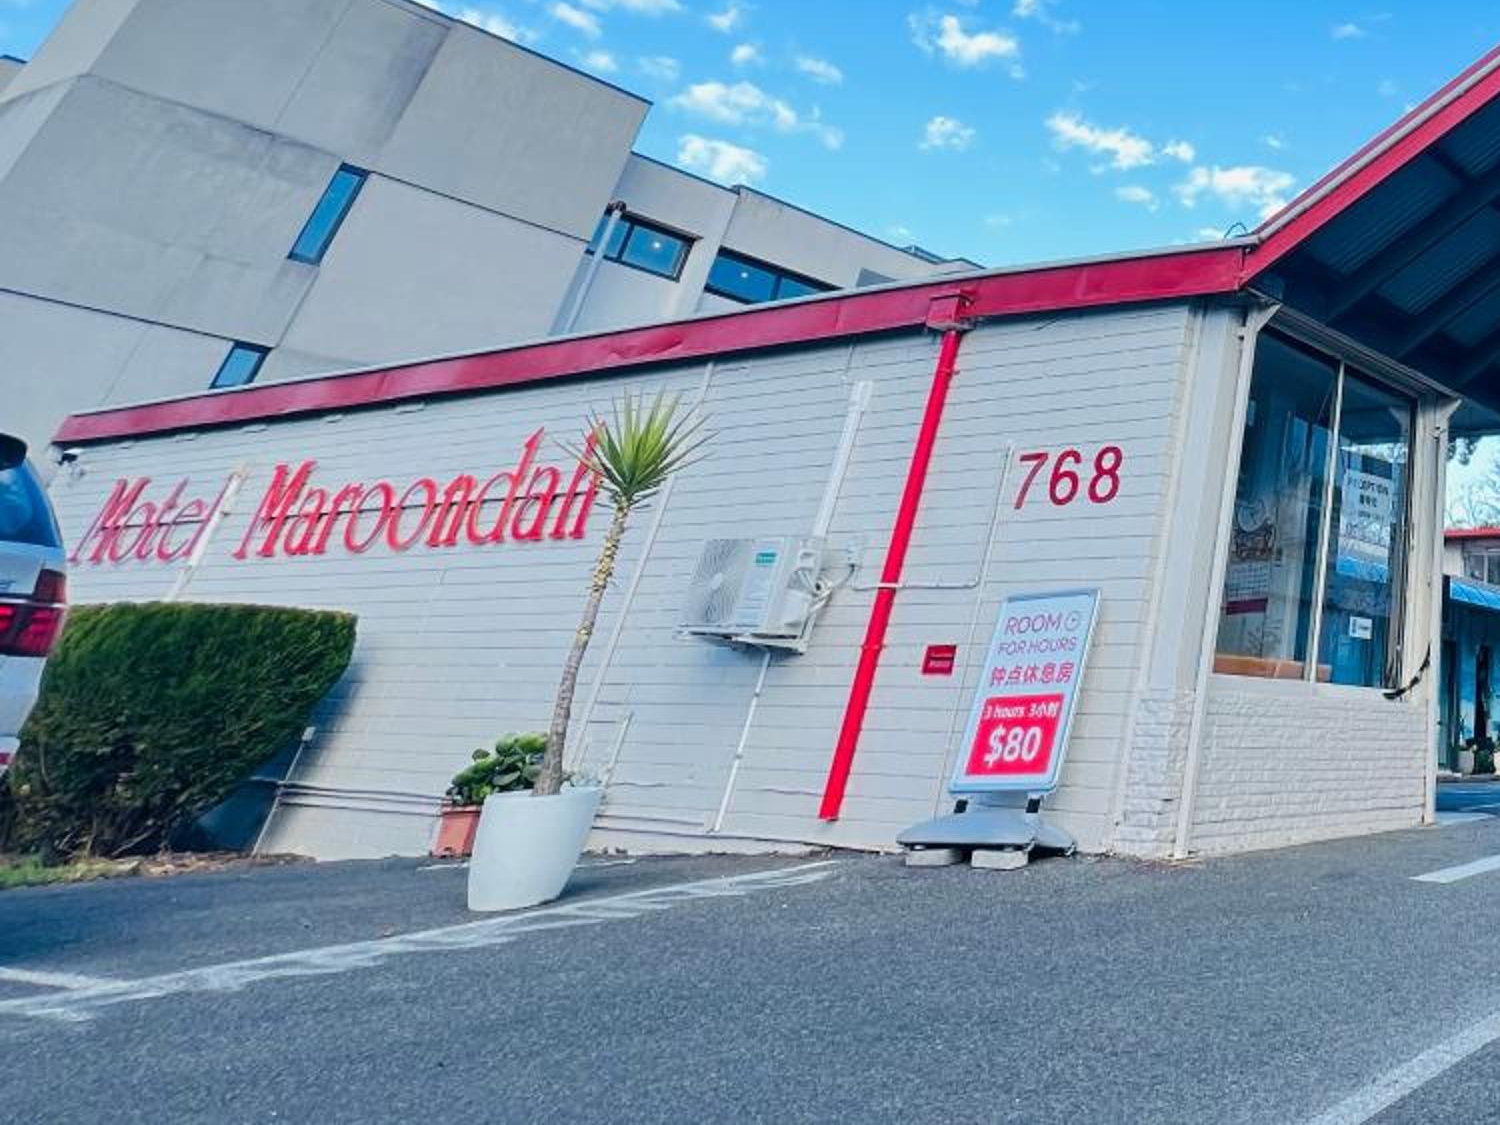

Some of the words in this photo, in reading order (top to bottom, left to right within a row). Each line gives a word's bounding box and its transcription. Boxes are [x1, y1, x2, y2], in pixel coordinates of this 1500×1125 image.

[1014, 446, 1122, 509] 768
[66, 475, 233, 563] Motel
[998, 640, 1025, 655] FOR
[1026, 636, 1077, 653] HOURS
[1004, 613, 1062, 635] ROOM
[983, 723, 1042, 769] $80
